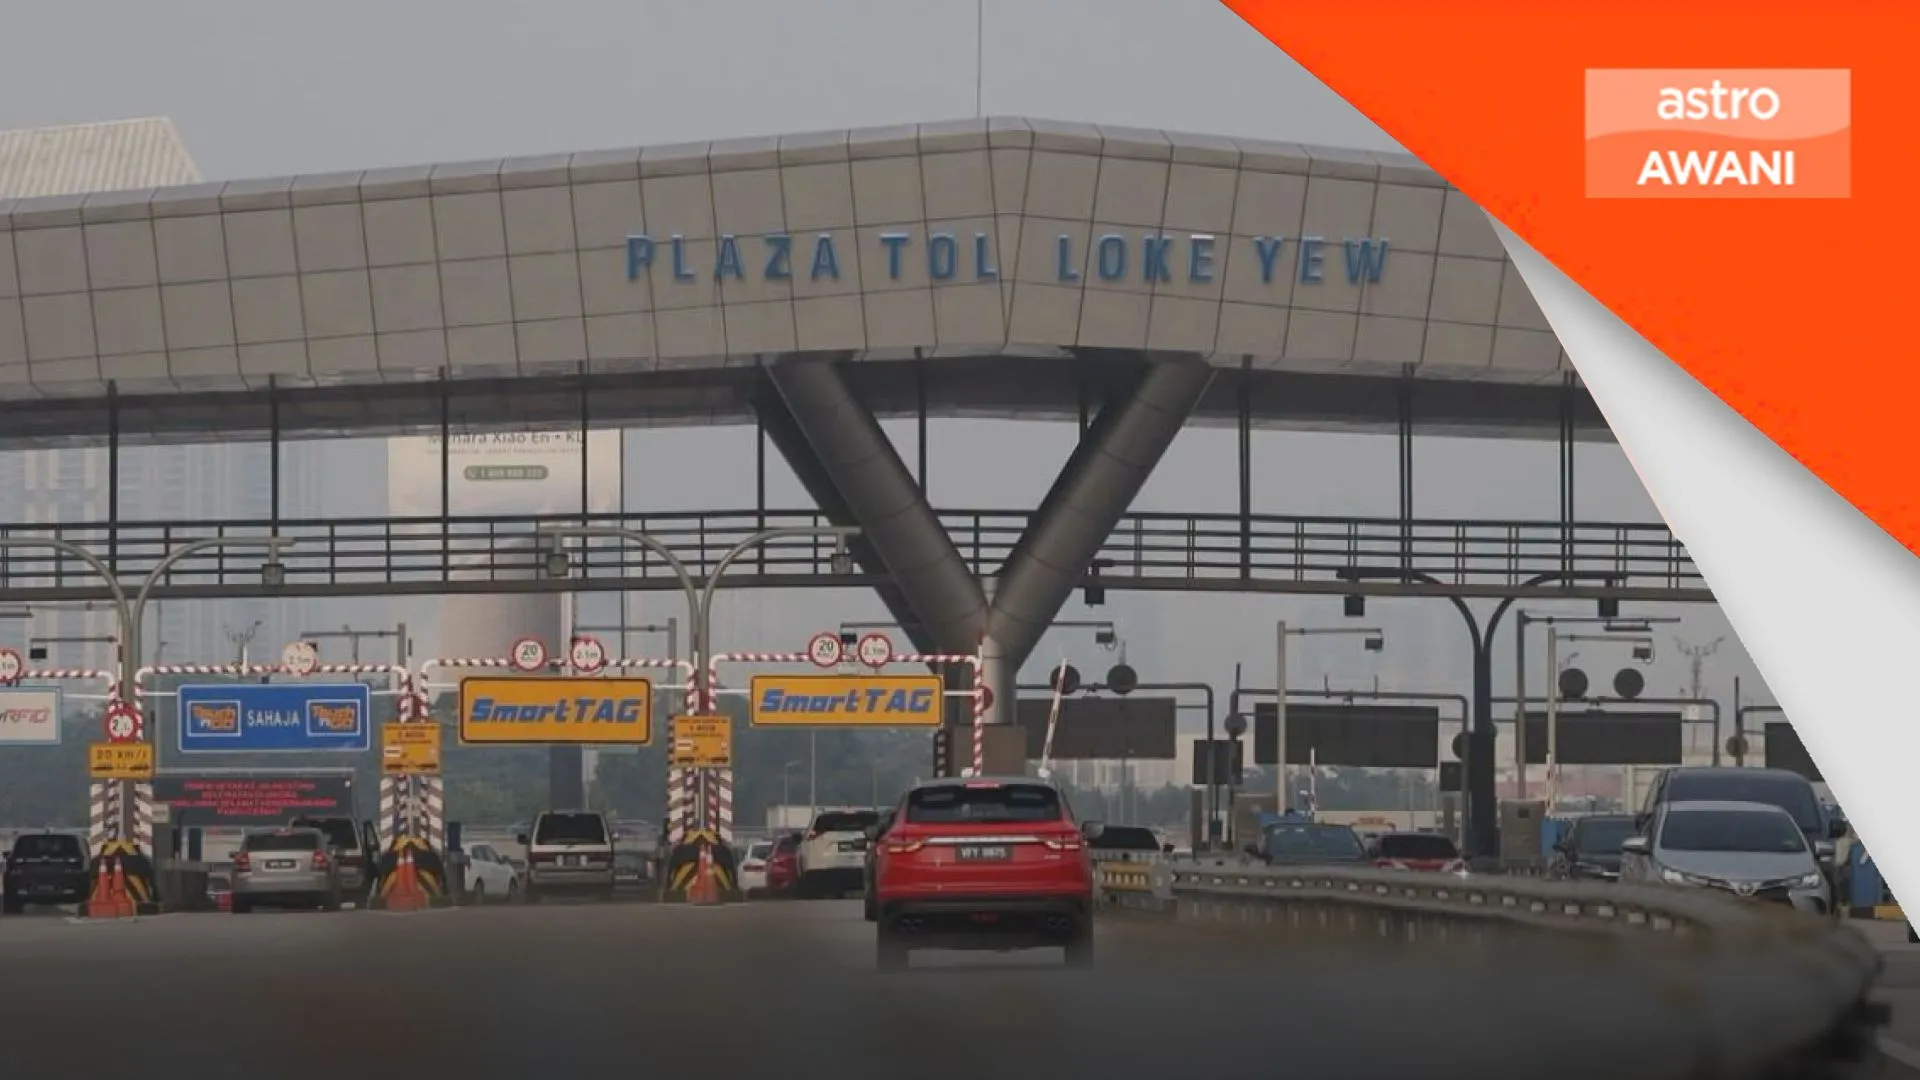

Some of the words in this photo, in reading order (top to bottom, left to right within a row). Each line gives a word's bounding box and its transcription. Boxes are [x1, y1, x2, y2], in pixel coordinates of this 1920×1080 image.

[626, 233, 840, 282] PLAZA
[880, 232, 998, 281] TOL
[1057, 233, 1216, 283] LOKE
[1253, 235, 1390, 285] YEW
[247, 710, 300, 727] SAHAJA
